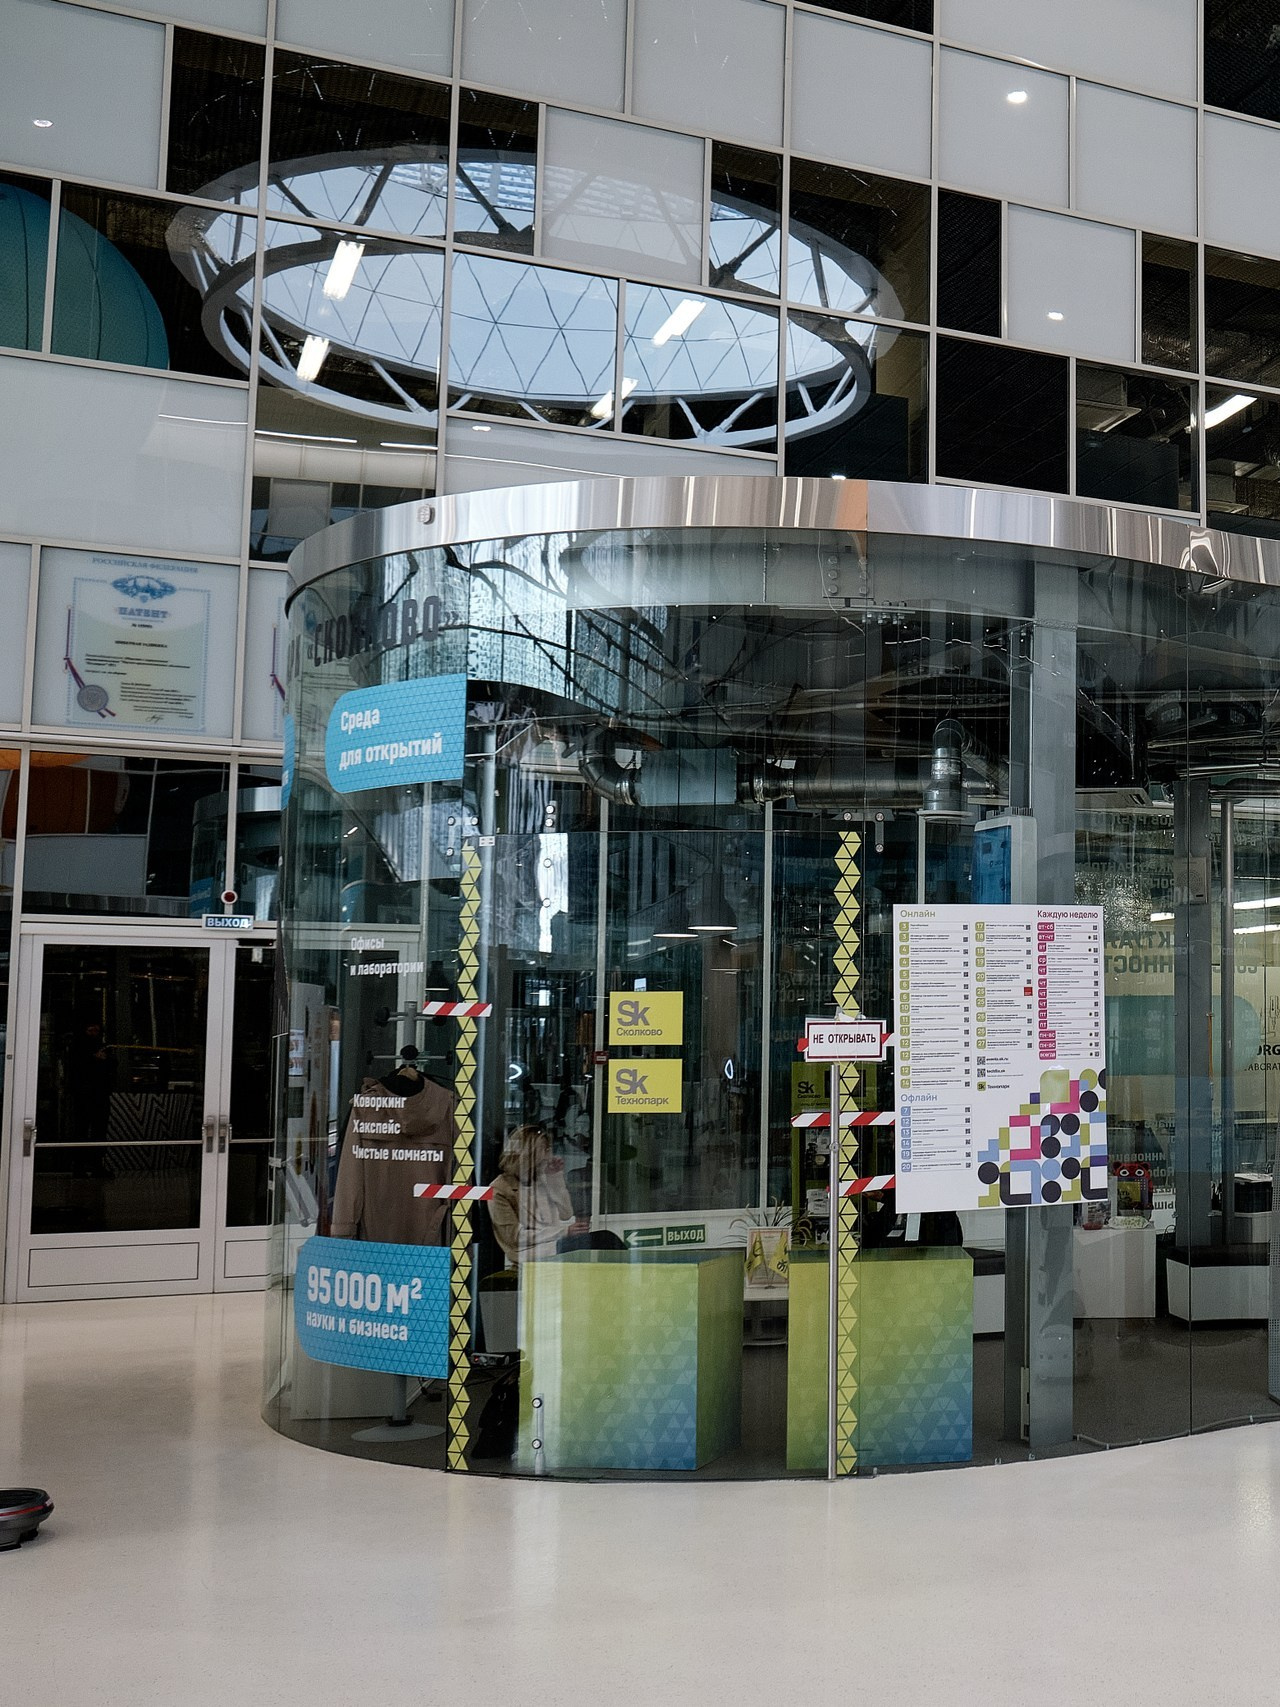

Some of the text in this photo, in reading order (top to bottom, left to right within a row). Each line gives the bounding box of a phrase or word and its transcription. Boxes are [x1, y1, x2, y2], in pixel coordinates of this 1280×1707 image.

[118, 607, 168, 618] ПАТЕНТ
[341, 708, 380, 734] Среда
[339, 732, 442, 771] для открытий
[900, 910, 935, 918] Онлайн
[1037, 910, 1098, 920] Каждую неделю
[206, 917, 250, 929] ВЫХОД
[351, 936, 385, 953] Офисы
[350, 960, 424, 978] и лаборатории
[616, 1000, 650, 1027] Sk
[616, 1027, 662, 1037] Сколково
[812, 1033, 876, 1044] НЕ ОТКРЫВАТЬ
[615, 1069, 648, 1095] Sk
[797, 1081, 815, 1095] Sk
[353, 1094, 407, 1111] Коворкинг
[615, 1094, 668, 1106] Технопарк
[900, 1093, 937, 1103] Офлайн
[353, 1118, 401, 1134] Хакспейс
[352, 1145, 443, 1162] Чистые комнаты
[667, 1226, 705, 1243] ВЫХОД
[306, 1311, 408, 1341] науки и бизнеса
